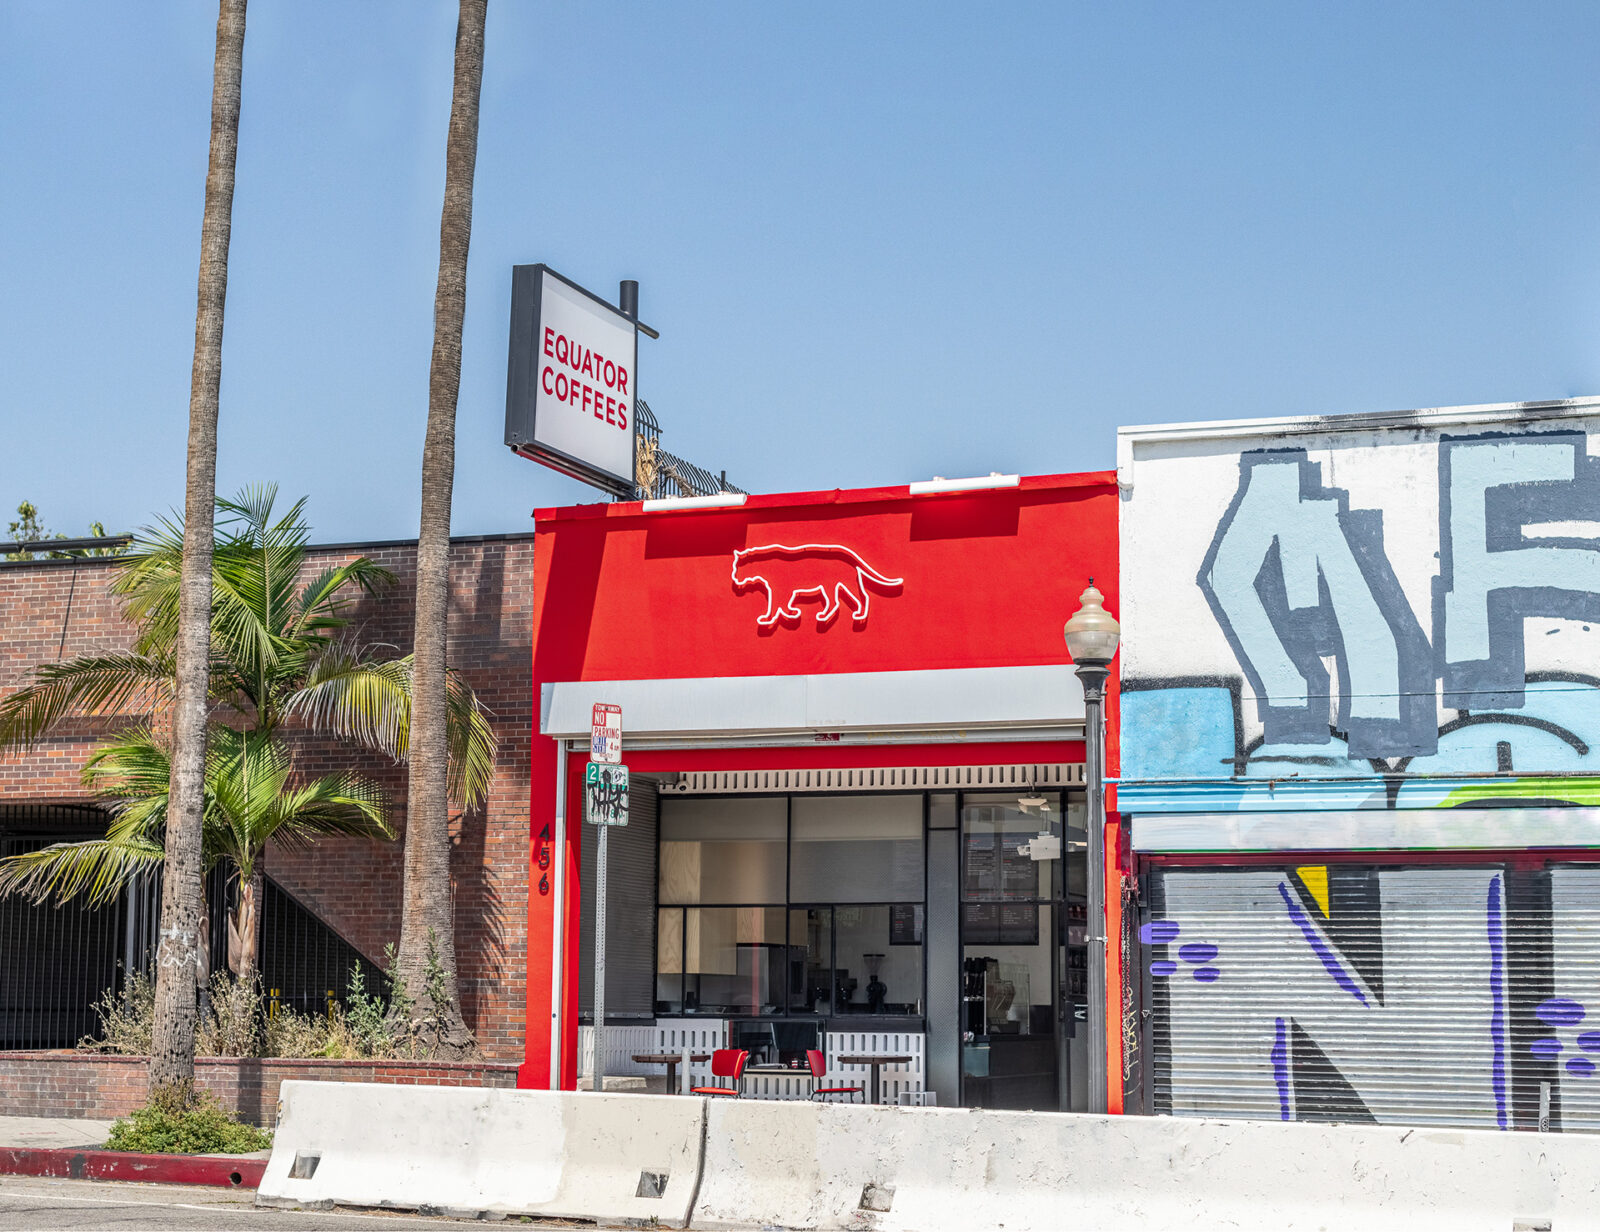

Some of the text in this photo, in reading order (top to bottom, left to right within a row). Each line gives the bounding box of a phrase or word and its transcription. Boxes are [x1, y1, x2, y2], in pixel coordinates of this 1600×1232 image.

[543, 326, 628, 396] EQUATOR
[542, 366, 628, 431] COFFEES
[594, 711, 605, 725] NO
[594, 726, 620, 740] PARKING
[609, 742, 614, 751] 4
[589, 765, 597, 780] 2
[538, 823, 550, 891] 456
